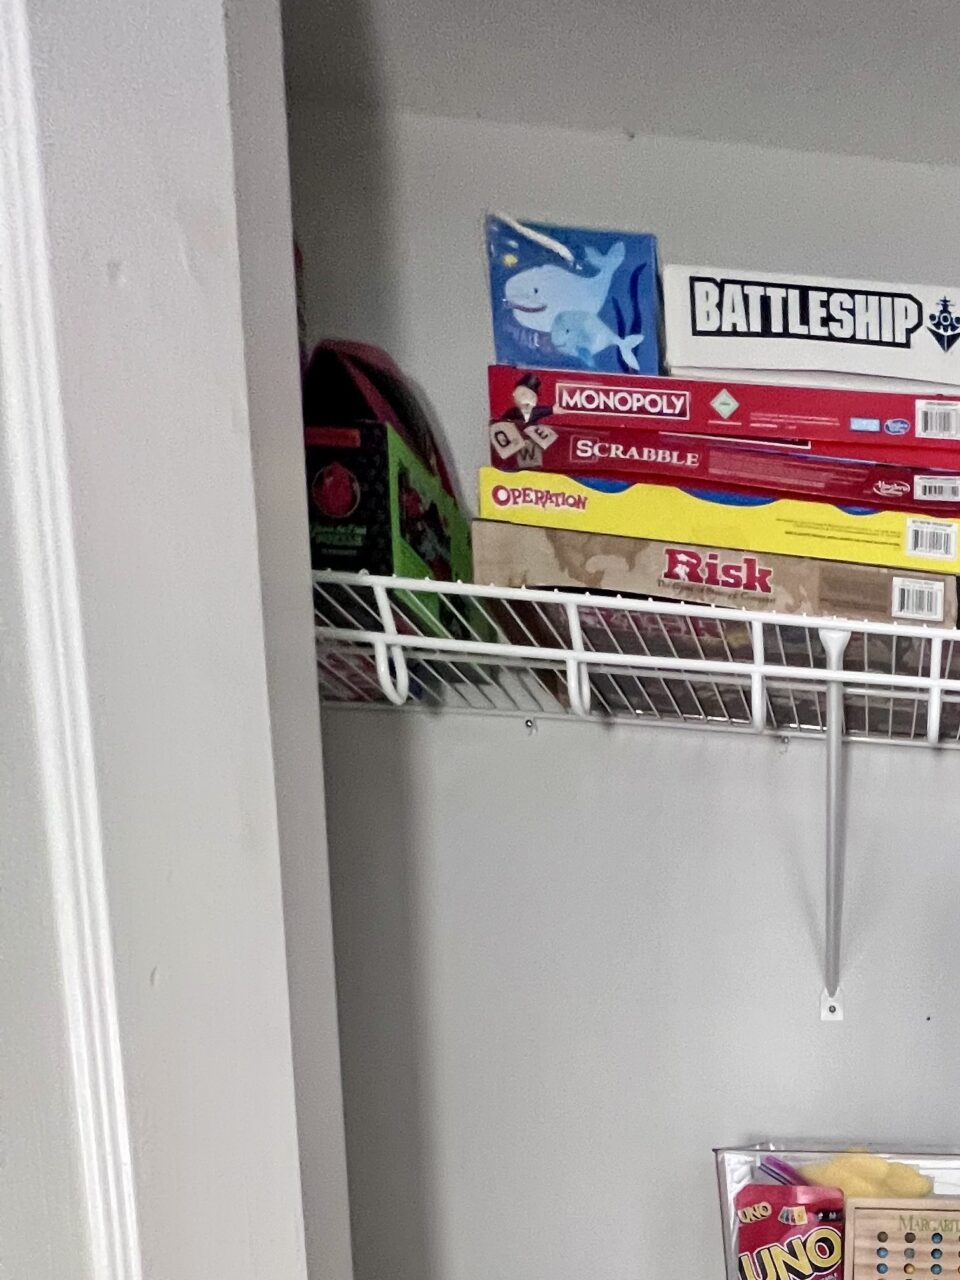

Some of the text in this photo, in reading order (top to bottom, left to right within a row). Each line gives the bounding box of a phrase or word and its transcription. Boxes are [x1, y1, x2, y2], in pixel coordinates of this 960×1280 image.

[691, 278, 920, 347] BATTLESHIP
[561, 389, 685, 415] MONOPOLY
[575, 439, 700, 467] SCRABBLE
[491, 484, 588, 510] OPERATION
[662, 547, 773, 594] Risk
[738, 1202, 772, 1223] UNO
